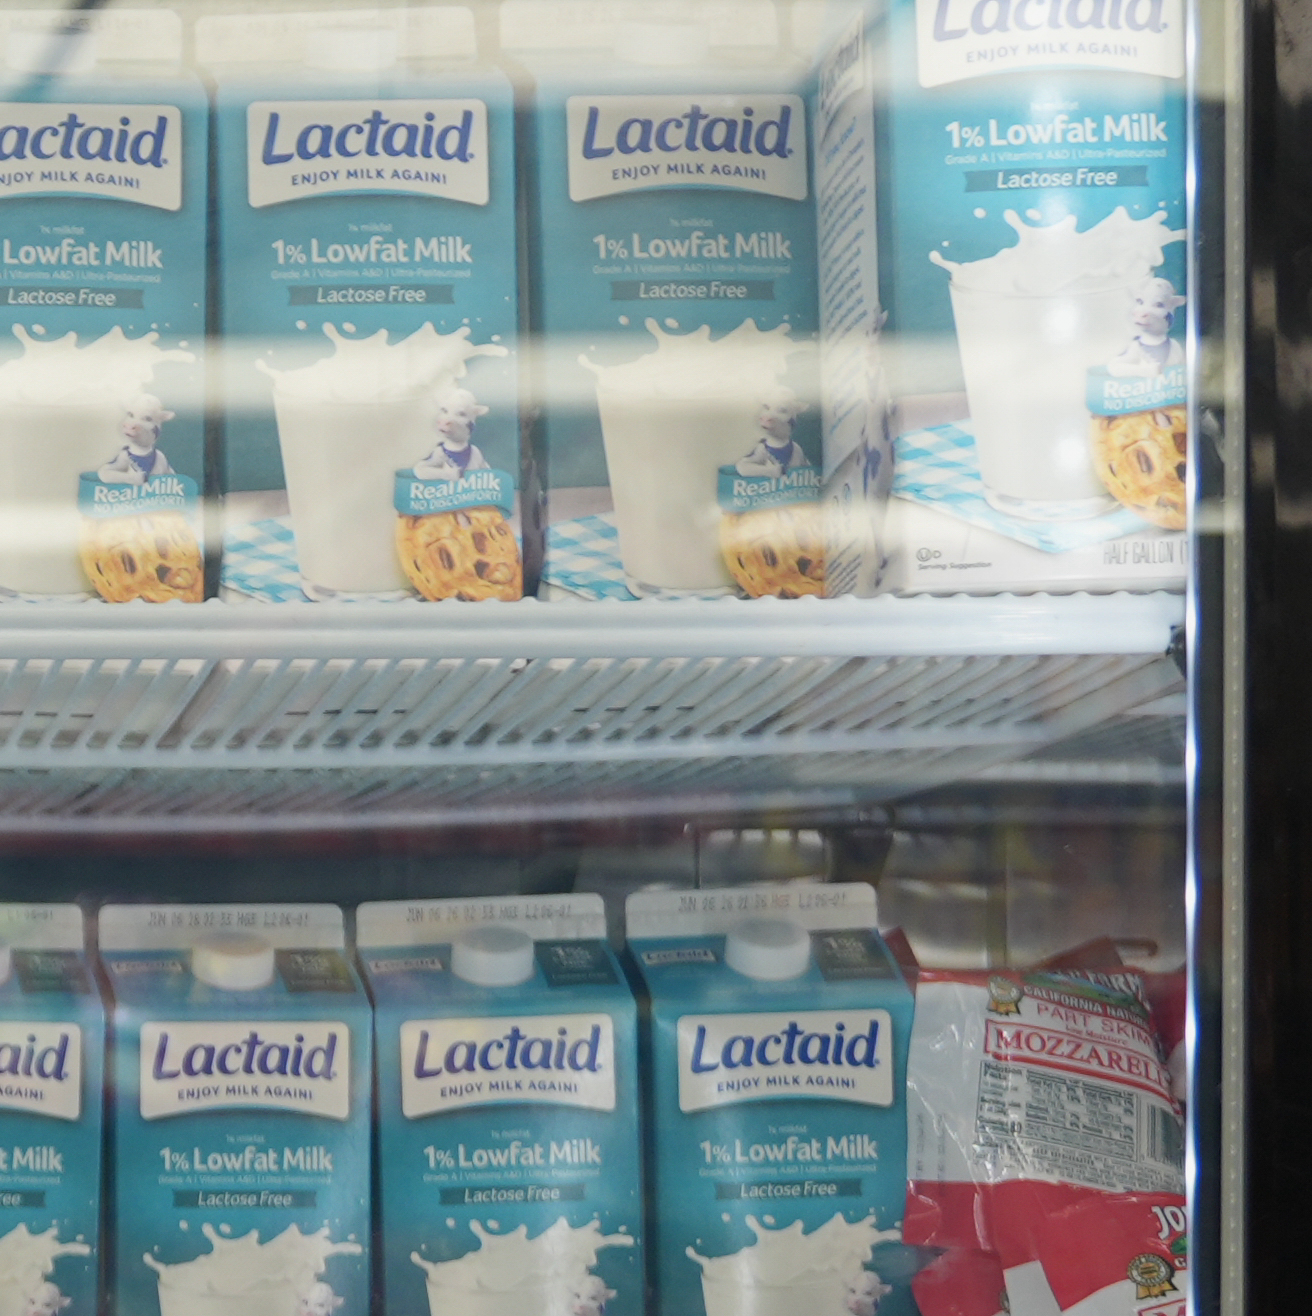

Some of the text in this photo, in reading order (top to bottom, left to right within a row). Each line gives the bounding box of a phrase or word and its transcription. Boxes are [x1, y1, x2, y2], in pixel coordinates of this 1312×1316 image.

[262, 109, 475, 166] Lactaid
[582, 104, 793, 160] Lactaid
[945, 114, 1167, 148] 1% Lowfat Milk
[40, 170, 78, 184] MILK
[84, 172, 140, 189] AGAIN!
[996, 168, 1117, 189] Lactose Free
[3, 239, 100, 267] Lowfat
[105, 241, 164, 269] Milk
[271, 238, 473, 265] 1% Lowfat Milk
[593, 232, 792, 259] 1% Lowfat Milk
[7, 287, 116, 306] Lactose Free
[317, 286, 426, 303] Lactose Free
[1037, 1002, 1091, 1026] PART
[152, 1032, 337, 1082] Lactaid
[413, 1024, 601, 1078] Lactaid
[690, 1020, 879, 1074] Lactaid
[424, 1139, 601, 1168] 1% Lowfat Milk
[700, 1134, 878, 1163] 1% Lowfat Milk
